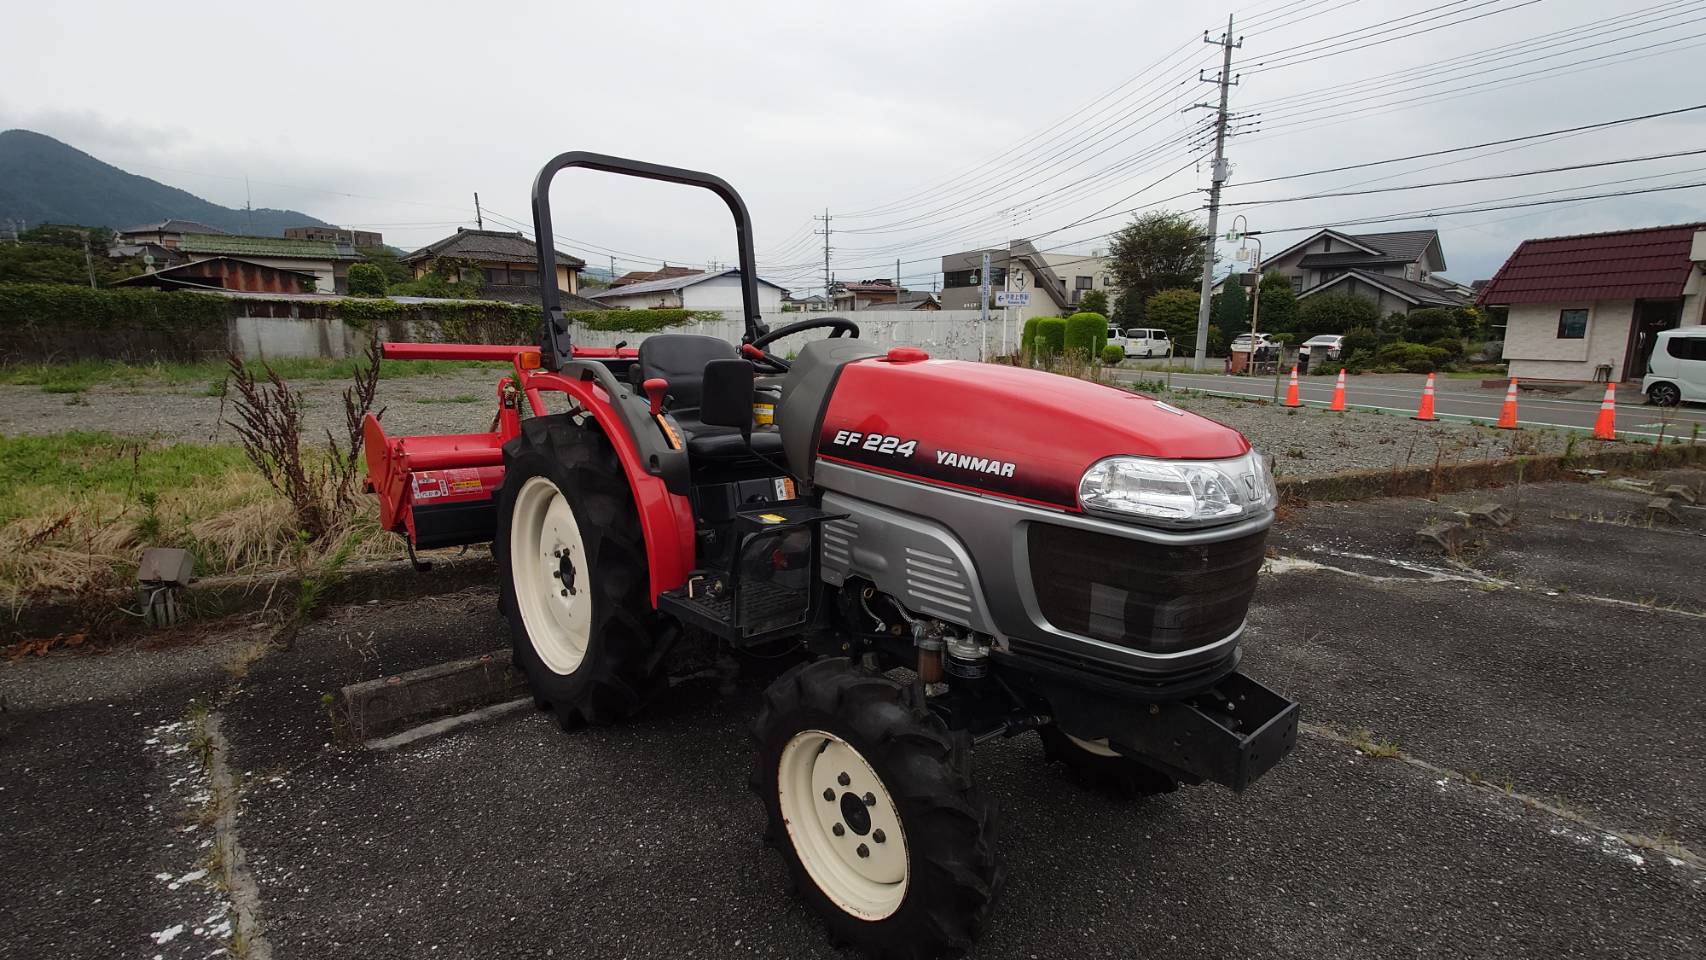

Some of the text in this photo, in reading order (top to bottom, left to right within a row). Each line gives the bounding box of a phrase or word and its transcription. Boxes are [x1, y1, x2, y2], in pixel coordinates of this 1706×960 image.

[833, 430, 917, 458] EF 224
[936, 450, 1016, 478] YANMAR
